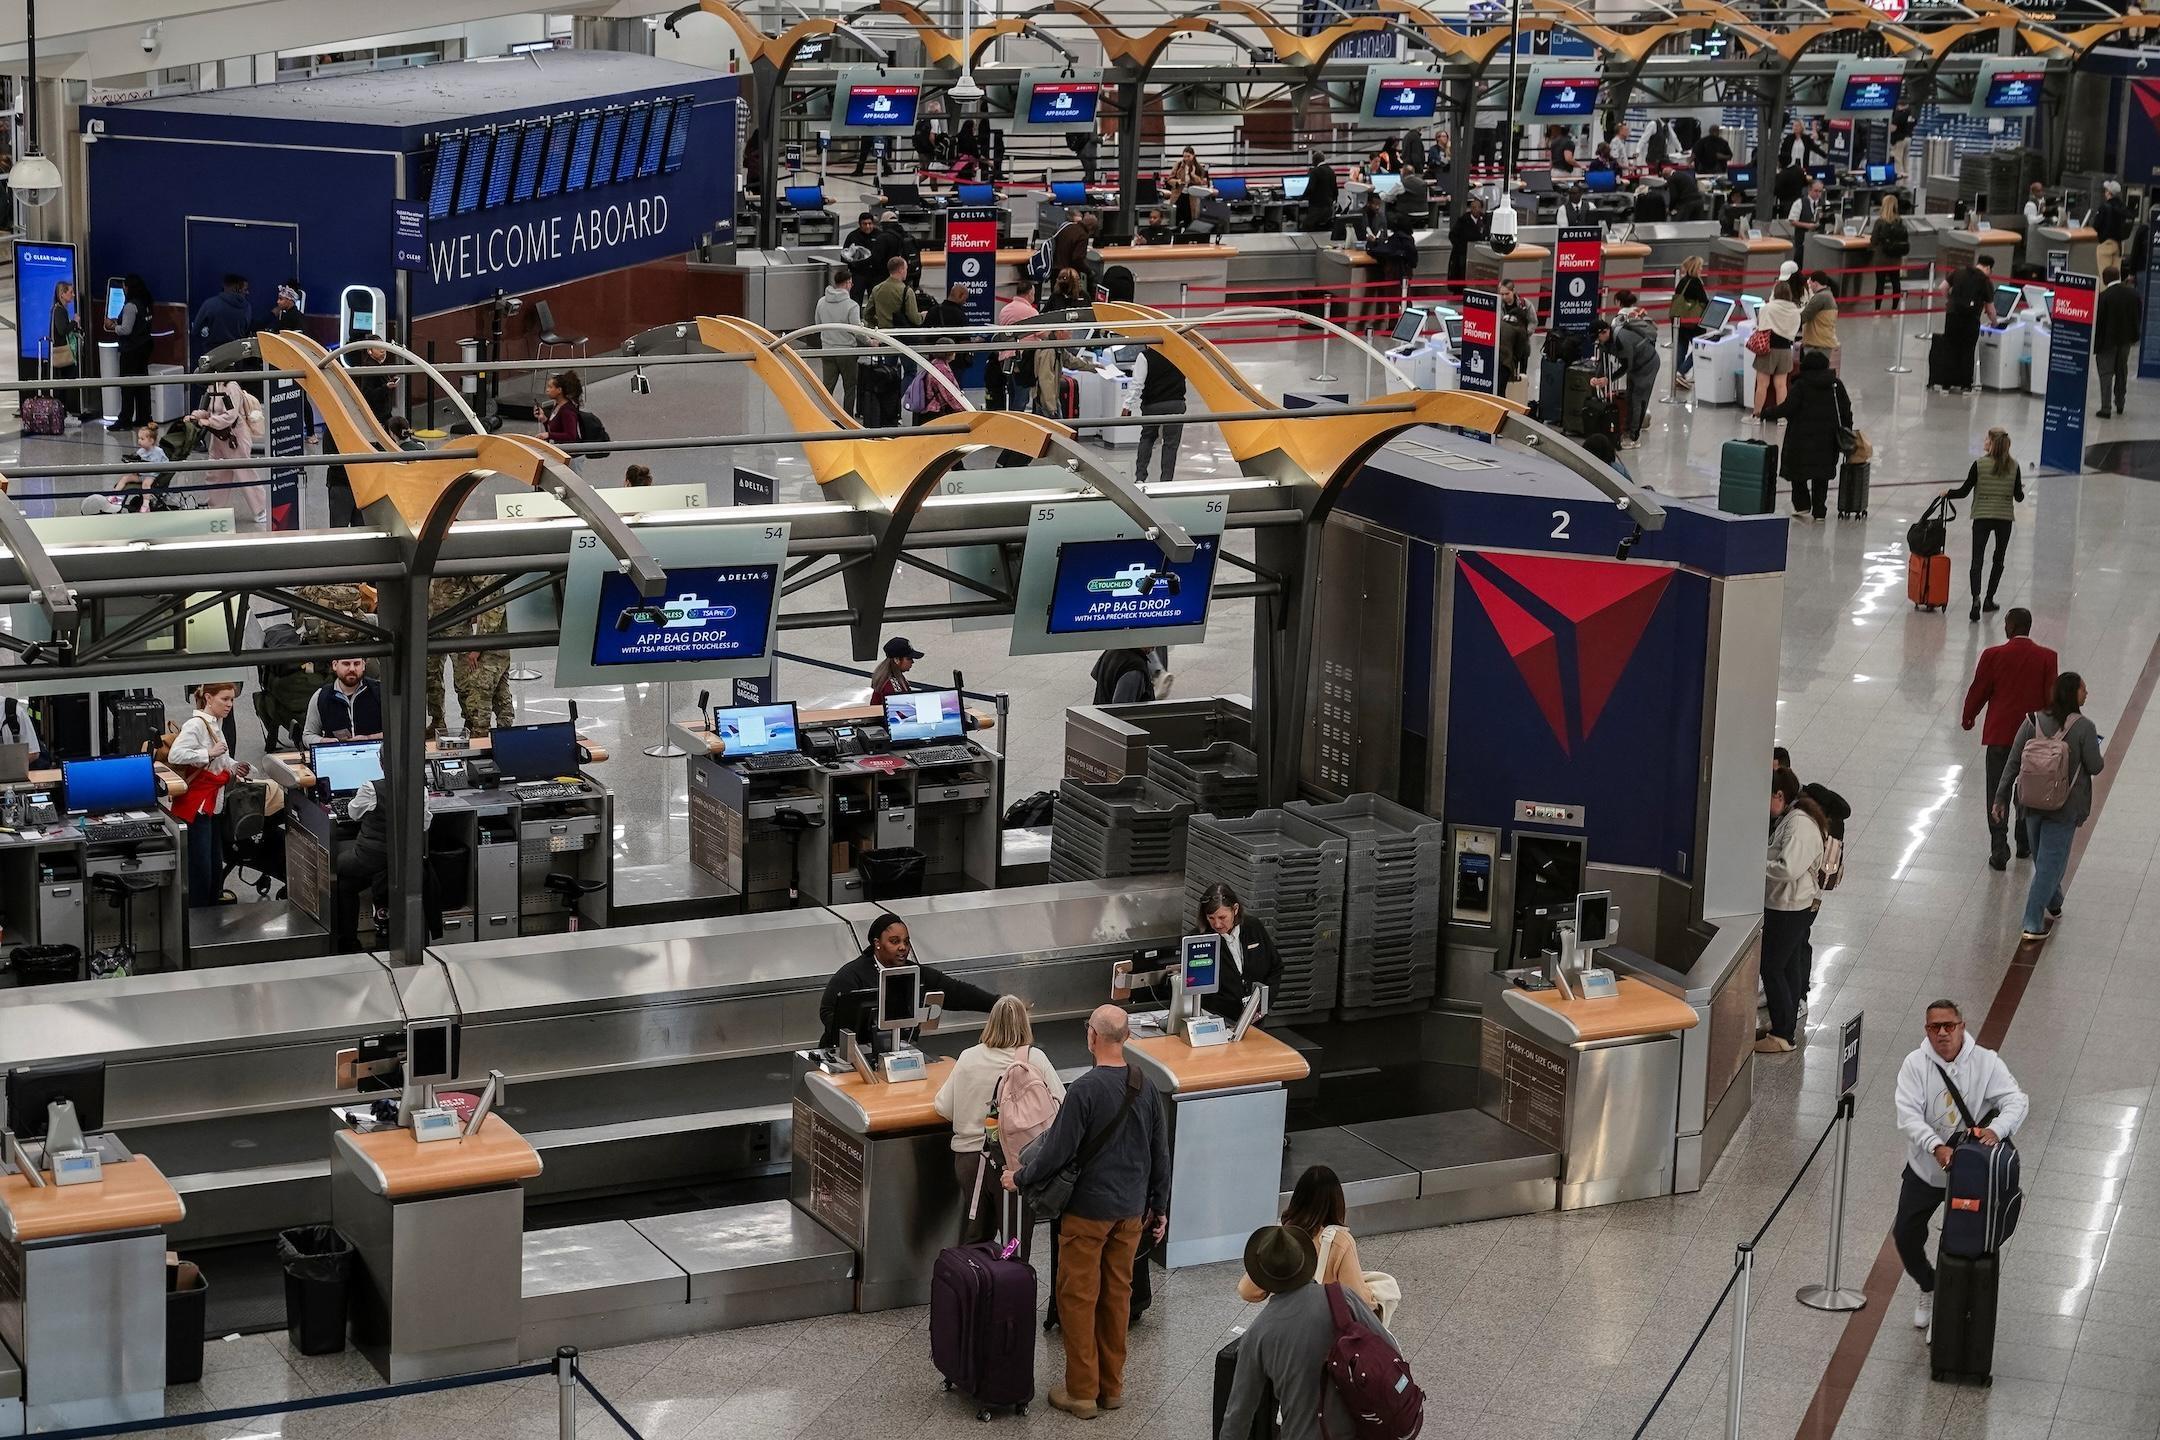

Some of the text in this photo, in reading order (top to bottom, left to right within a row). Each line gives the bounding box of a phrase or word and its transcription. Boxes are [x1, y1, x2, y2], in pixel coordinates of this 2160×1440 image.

[430, 195, 668, 284] WELCOME ABOARD
[967, 262, 974, 273] 2
[1472, 296, 1488, 306] DELTA
[2056, 299, 2071, 307] SKY
[2055, 306, 2089, 318] PRIORITY
[1464, 321, 1477, 330] SKY
[1464, 328, 1491, 340] PRIORITY
[1471, 377, 1479, 385] BAG
[1480, 378, 1492, 388] DROP
[271, 389, 300, 404] AGENT ASSIST
[745, 480, 764, 492] DELTA
[1206, 501, 1222, 512] 56
[1038, 509, 1055, 520] 55
[1551, 510, 1570, 539] 2
[765, 527, 783, 539] 54
[578, 536, 596, 548] 53
[728, 572, 759, 581] DELTA
[1098, 580, 1132, 588] TOUCHLESS
[1089, 599, 1170, 613] APP BAG DROP
[1106, 612, 1138, 620] PRECHECK
[637, 631, 727, 644] APP BAG DROP
[691, 643, 730, 651] TOUCHLESS
[737, 679, 758, 693] CHECKED
[737, 688, 760, 703] BAGGAGE
[1094, 767, 1106, 778] CHECK
[1844, 1038, 1858, 1063] EXIT
[1507, 1040, 1565, 1075] CARRY-ON SIZE CHECK
[814, 1124, 862, 1161] CARRY-ON SIZE CHECK
